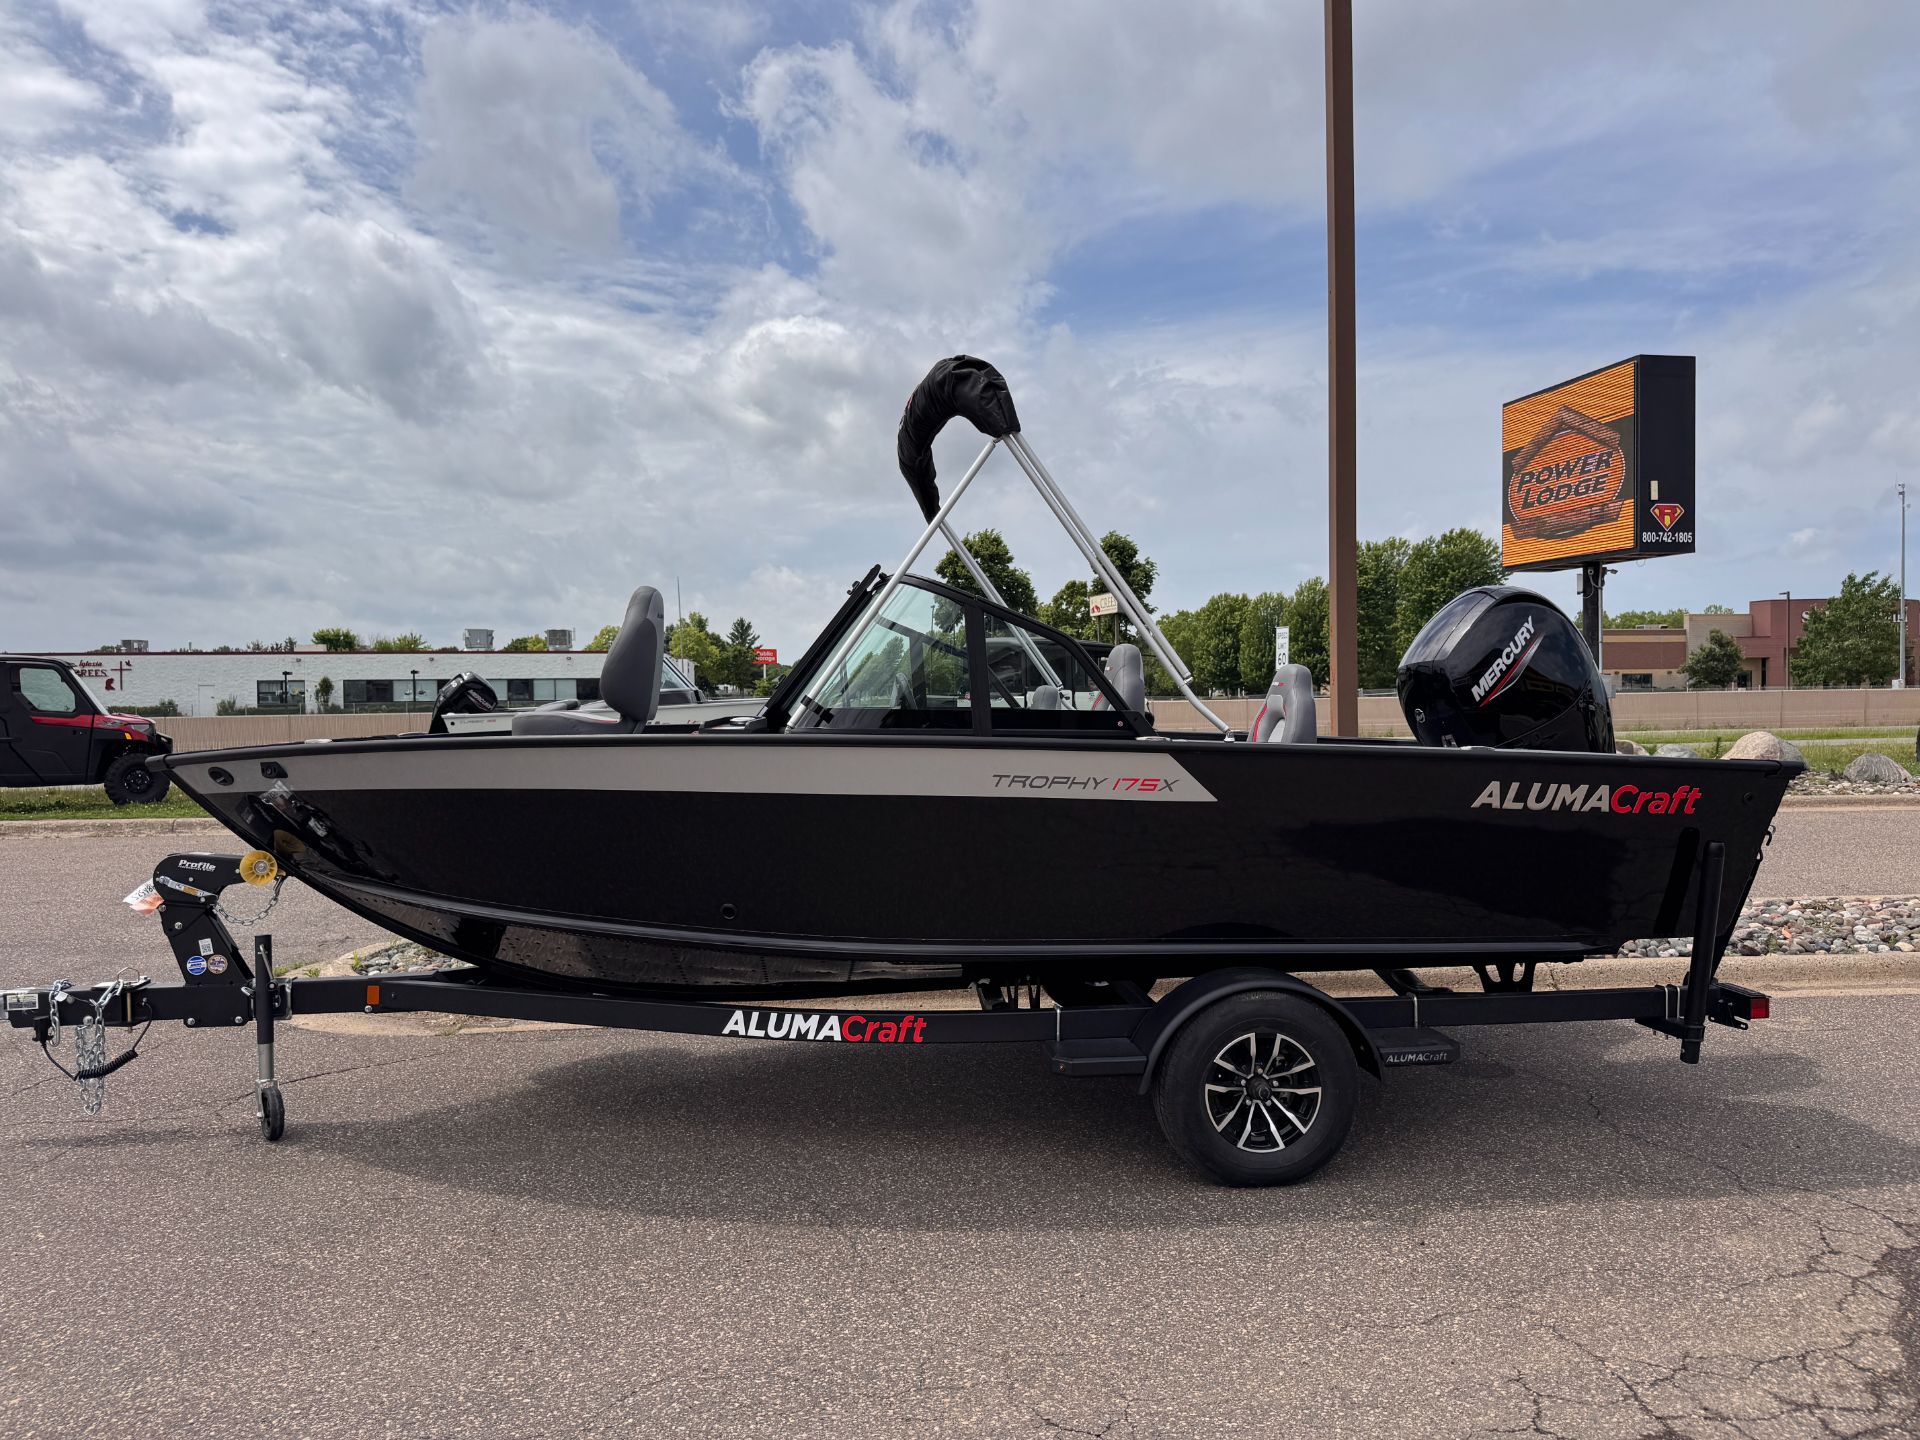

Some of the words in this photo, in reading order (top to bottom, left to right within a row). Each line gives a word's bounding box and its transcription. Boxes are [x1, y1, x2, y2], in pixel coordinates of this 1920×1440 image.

[1516, 450, 1614, 494] POWER
[1520, 473, 1611, 510] LODGE
[1642, 531, 1693, 543] 800-742-1805
[1277, 652, 1287, 666] 60
[1471, 615, 1536, 702] MERCURY
[992, 774, 1109, 790] TROPHY
[1112, 777, 1180, 793] 175X
[1470, 780, 1702, 815] ALUMACraft
[178, 859, 217, 871] Profile
[721, 1009, 928, 1043] ALUMACraft
[1385, 1050, 1448, 1063] ALUMACraft
